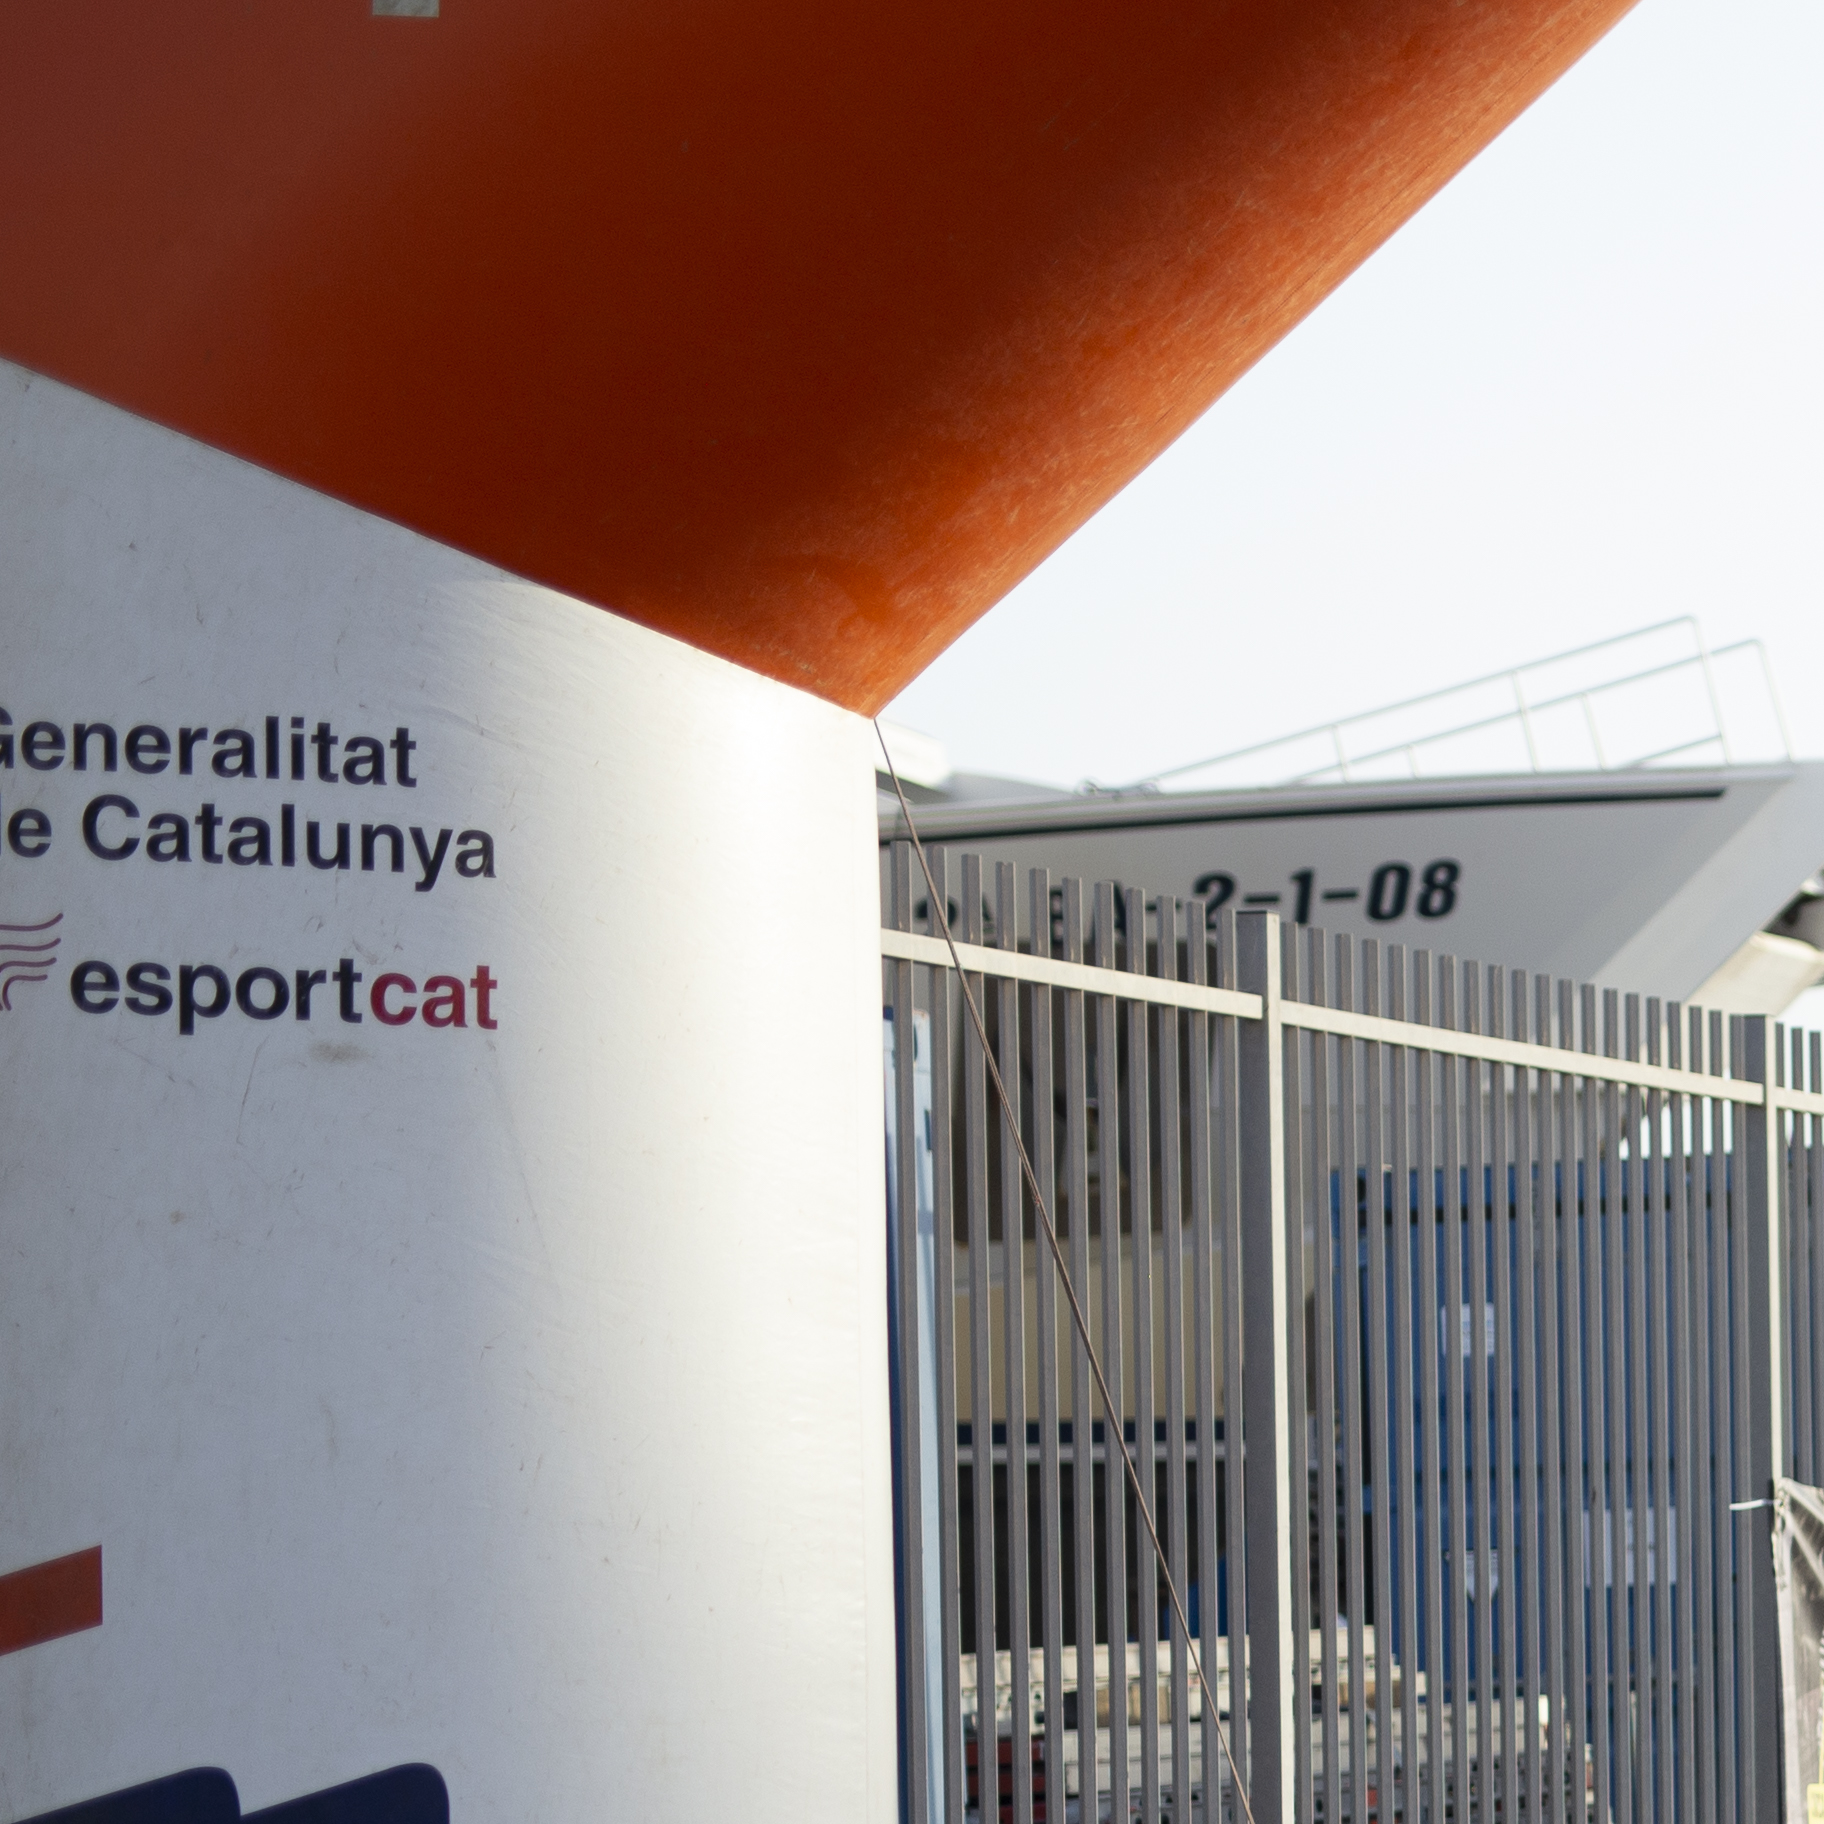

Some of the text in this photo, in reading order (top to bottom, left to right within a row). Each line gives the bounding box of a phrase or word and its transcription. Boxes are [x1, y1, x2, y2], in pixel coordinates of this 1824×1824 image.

[0, 705, 418, 787] eneralitat
[7, 794, 497, 892] e Catalunya
[69, 956, 499, 1036] esportcat
